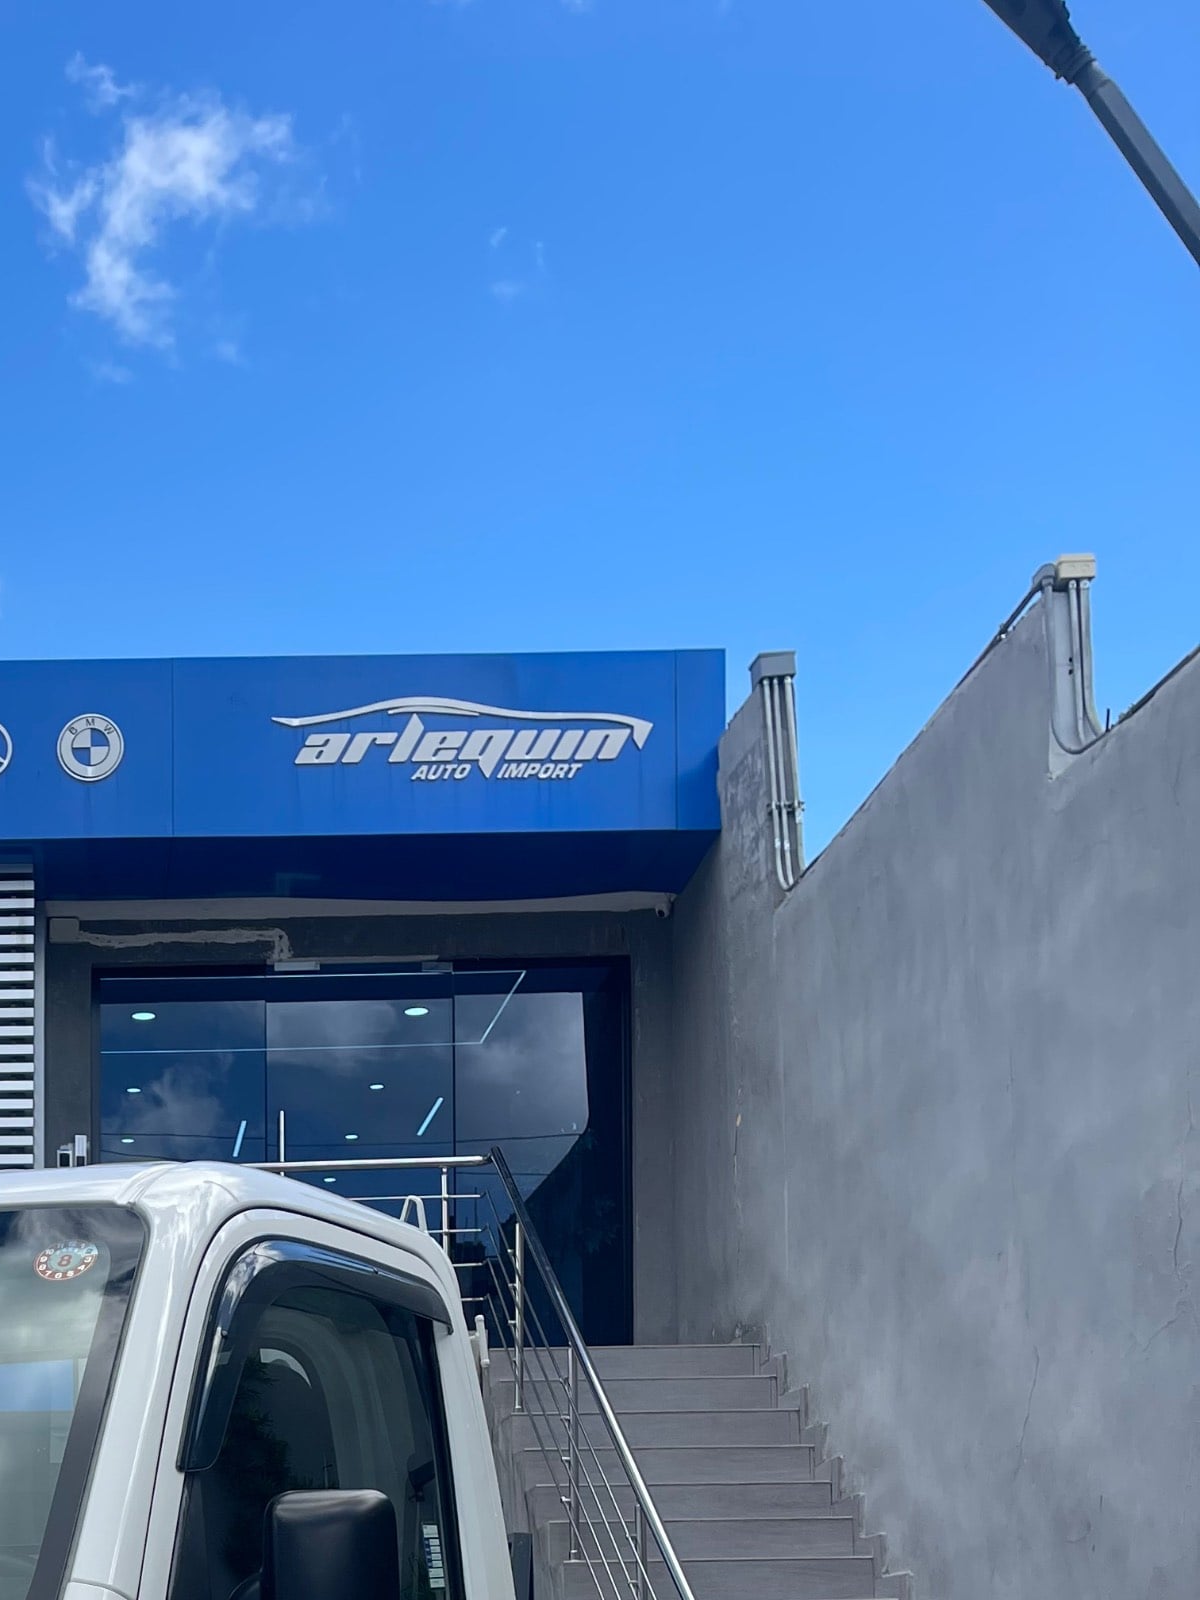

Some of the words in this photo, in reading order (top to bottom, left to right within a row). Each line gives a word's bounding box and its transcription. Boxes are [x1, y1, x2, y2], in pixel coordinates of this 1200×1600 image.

[68, 714, 115, 736] BMW
[410, 763, 471, 781] AUTO
[497, 763, 583, 780] IMPORT
[57, 1255, 73, 1267] 8
